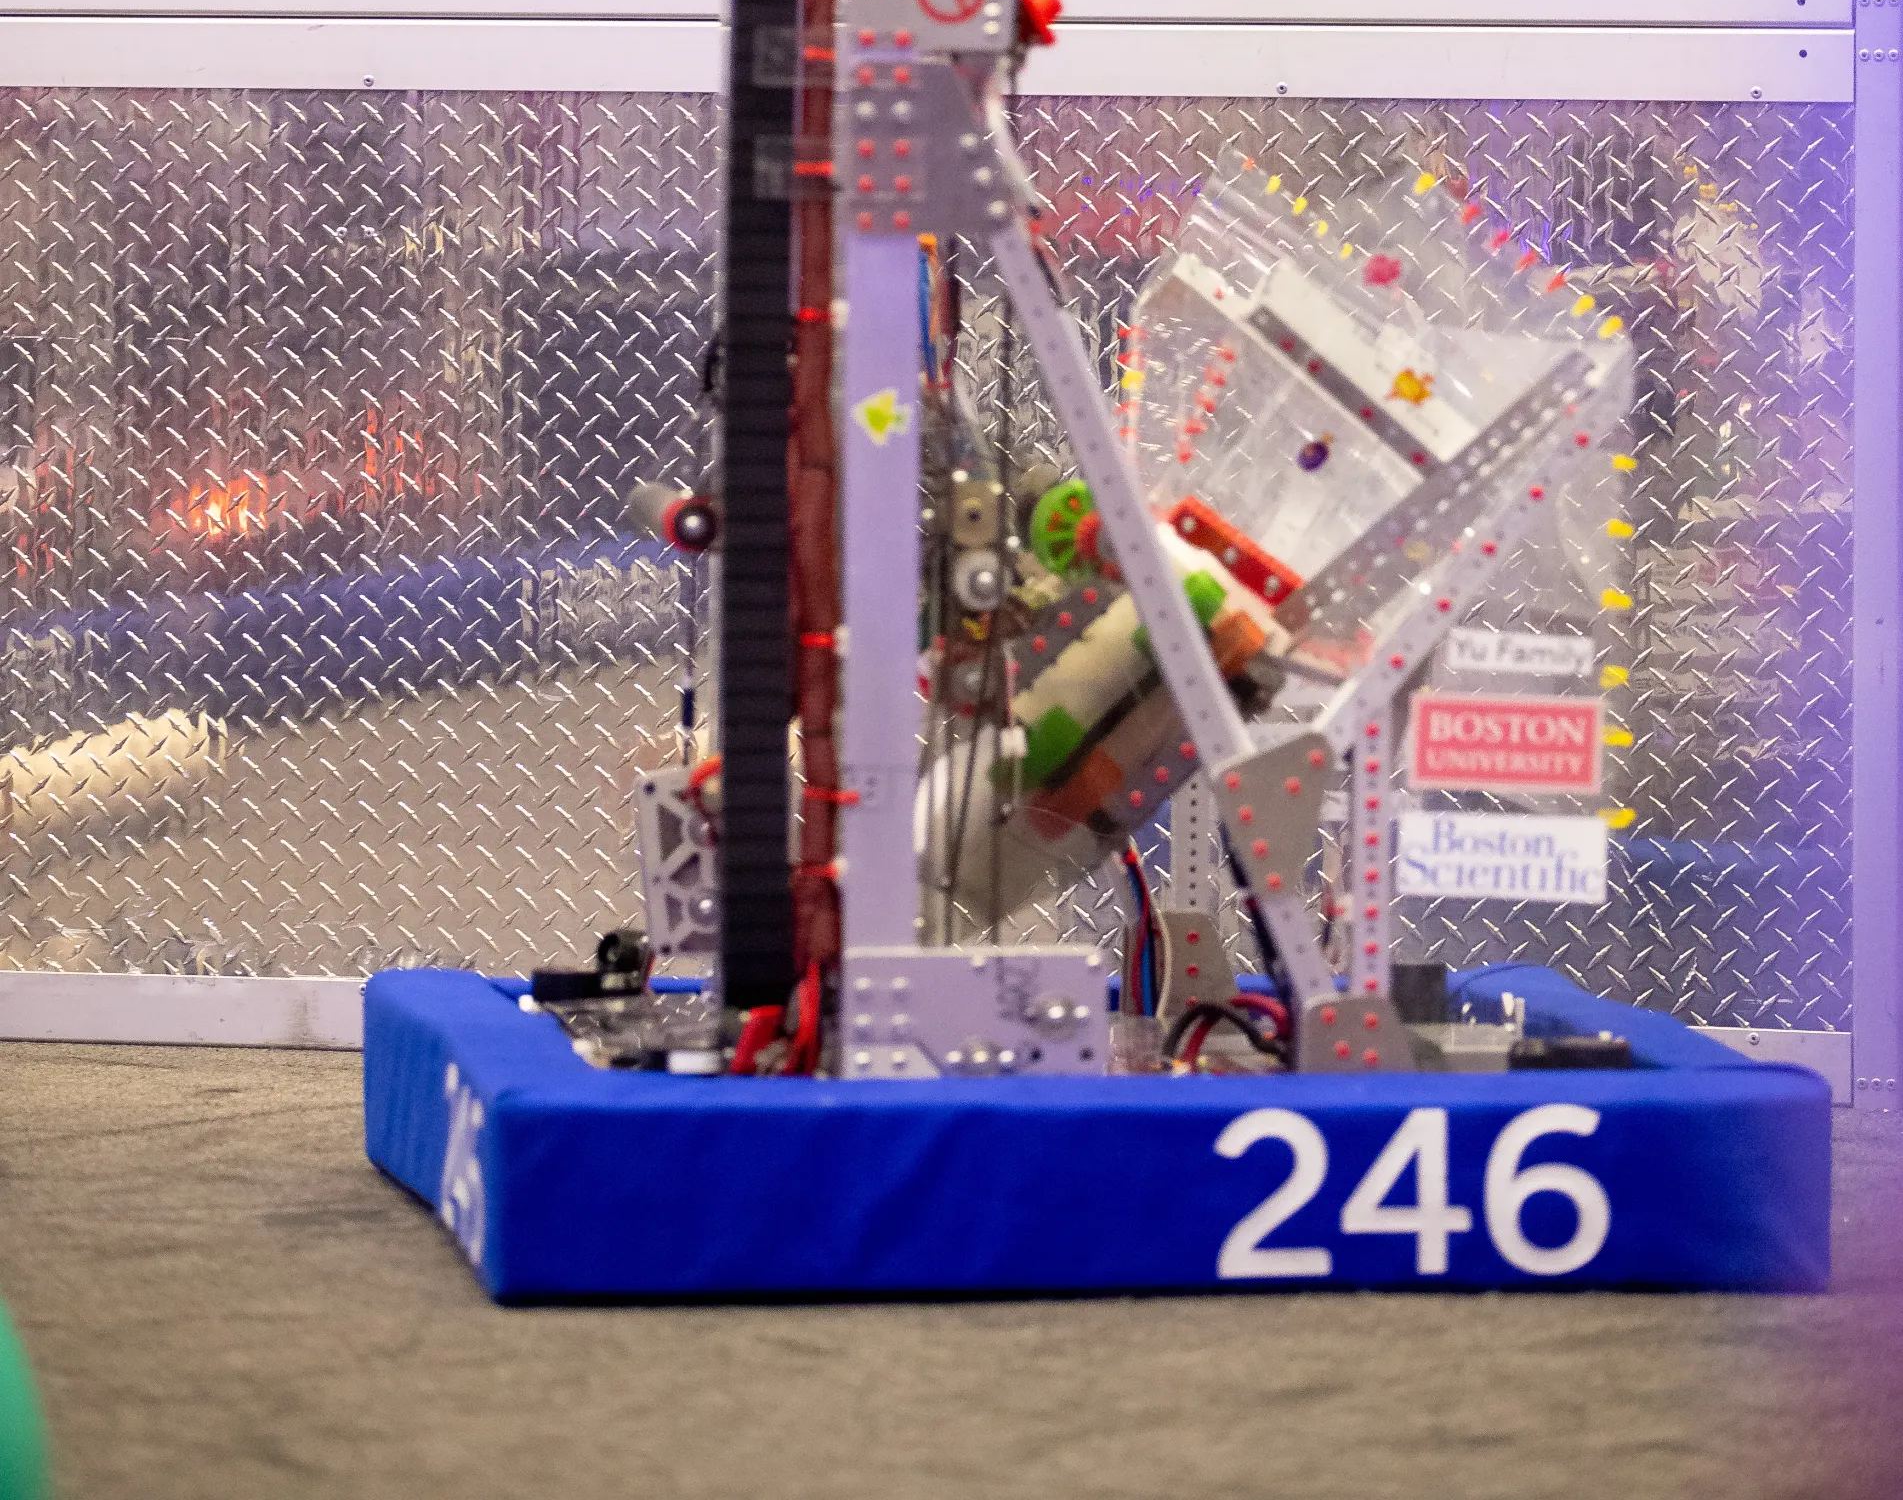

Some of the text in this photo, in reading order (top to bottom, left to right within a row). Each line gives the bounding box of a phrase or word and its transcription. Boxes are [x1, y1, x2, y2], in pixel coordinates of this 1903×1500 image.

[1428, 710, 1588, 747] BOSTON
[1425, 749, 1585, 777] UNIVERSITY
[1430, 817, 1556, 858] Boston
[1402, 842, 1597, 896] Scientific
[1213, 1103, 1612, 1280] 246
